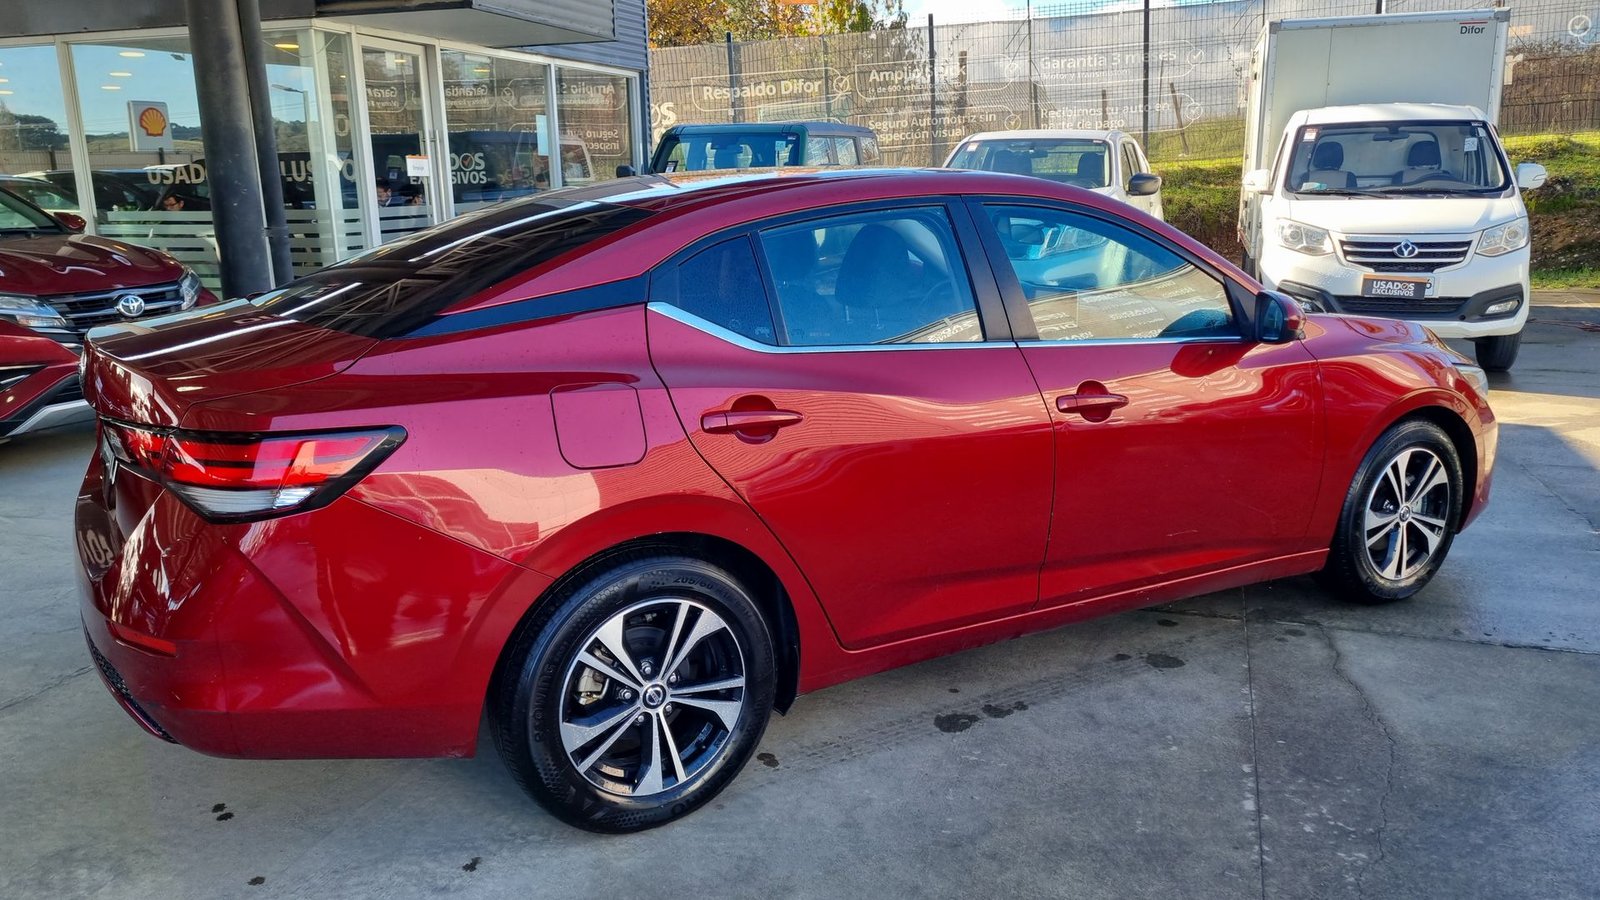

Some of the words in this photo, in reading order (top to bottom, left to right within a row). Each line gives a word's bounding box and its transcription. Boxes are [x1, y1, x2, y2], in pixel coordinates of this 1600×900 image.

[1460, 26, 1485, 34] Difor
[1125, 51, 1177, 64] mees
[703, 82, 776, 102] Respaldo
[781, 79, 821, 95] Difor
[868, 119, 909, 132] Seguro
[911, 114, 977, 127] Automotriz
[980, 112, 997, 122] sin
[1095, 118, 1125, 130] pago
[876, 128, 929, 143] spección
[931, 127, 965, 138] visual
[147, 163, 208, 185] USAD
[1372, 288, 1414, 297] EXCLUSIVOS
[1373, 281, 1415, 291] USADOS
